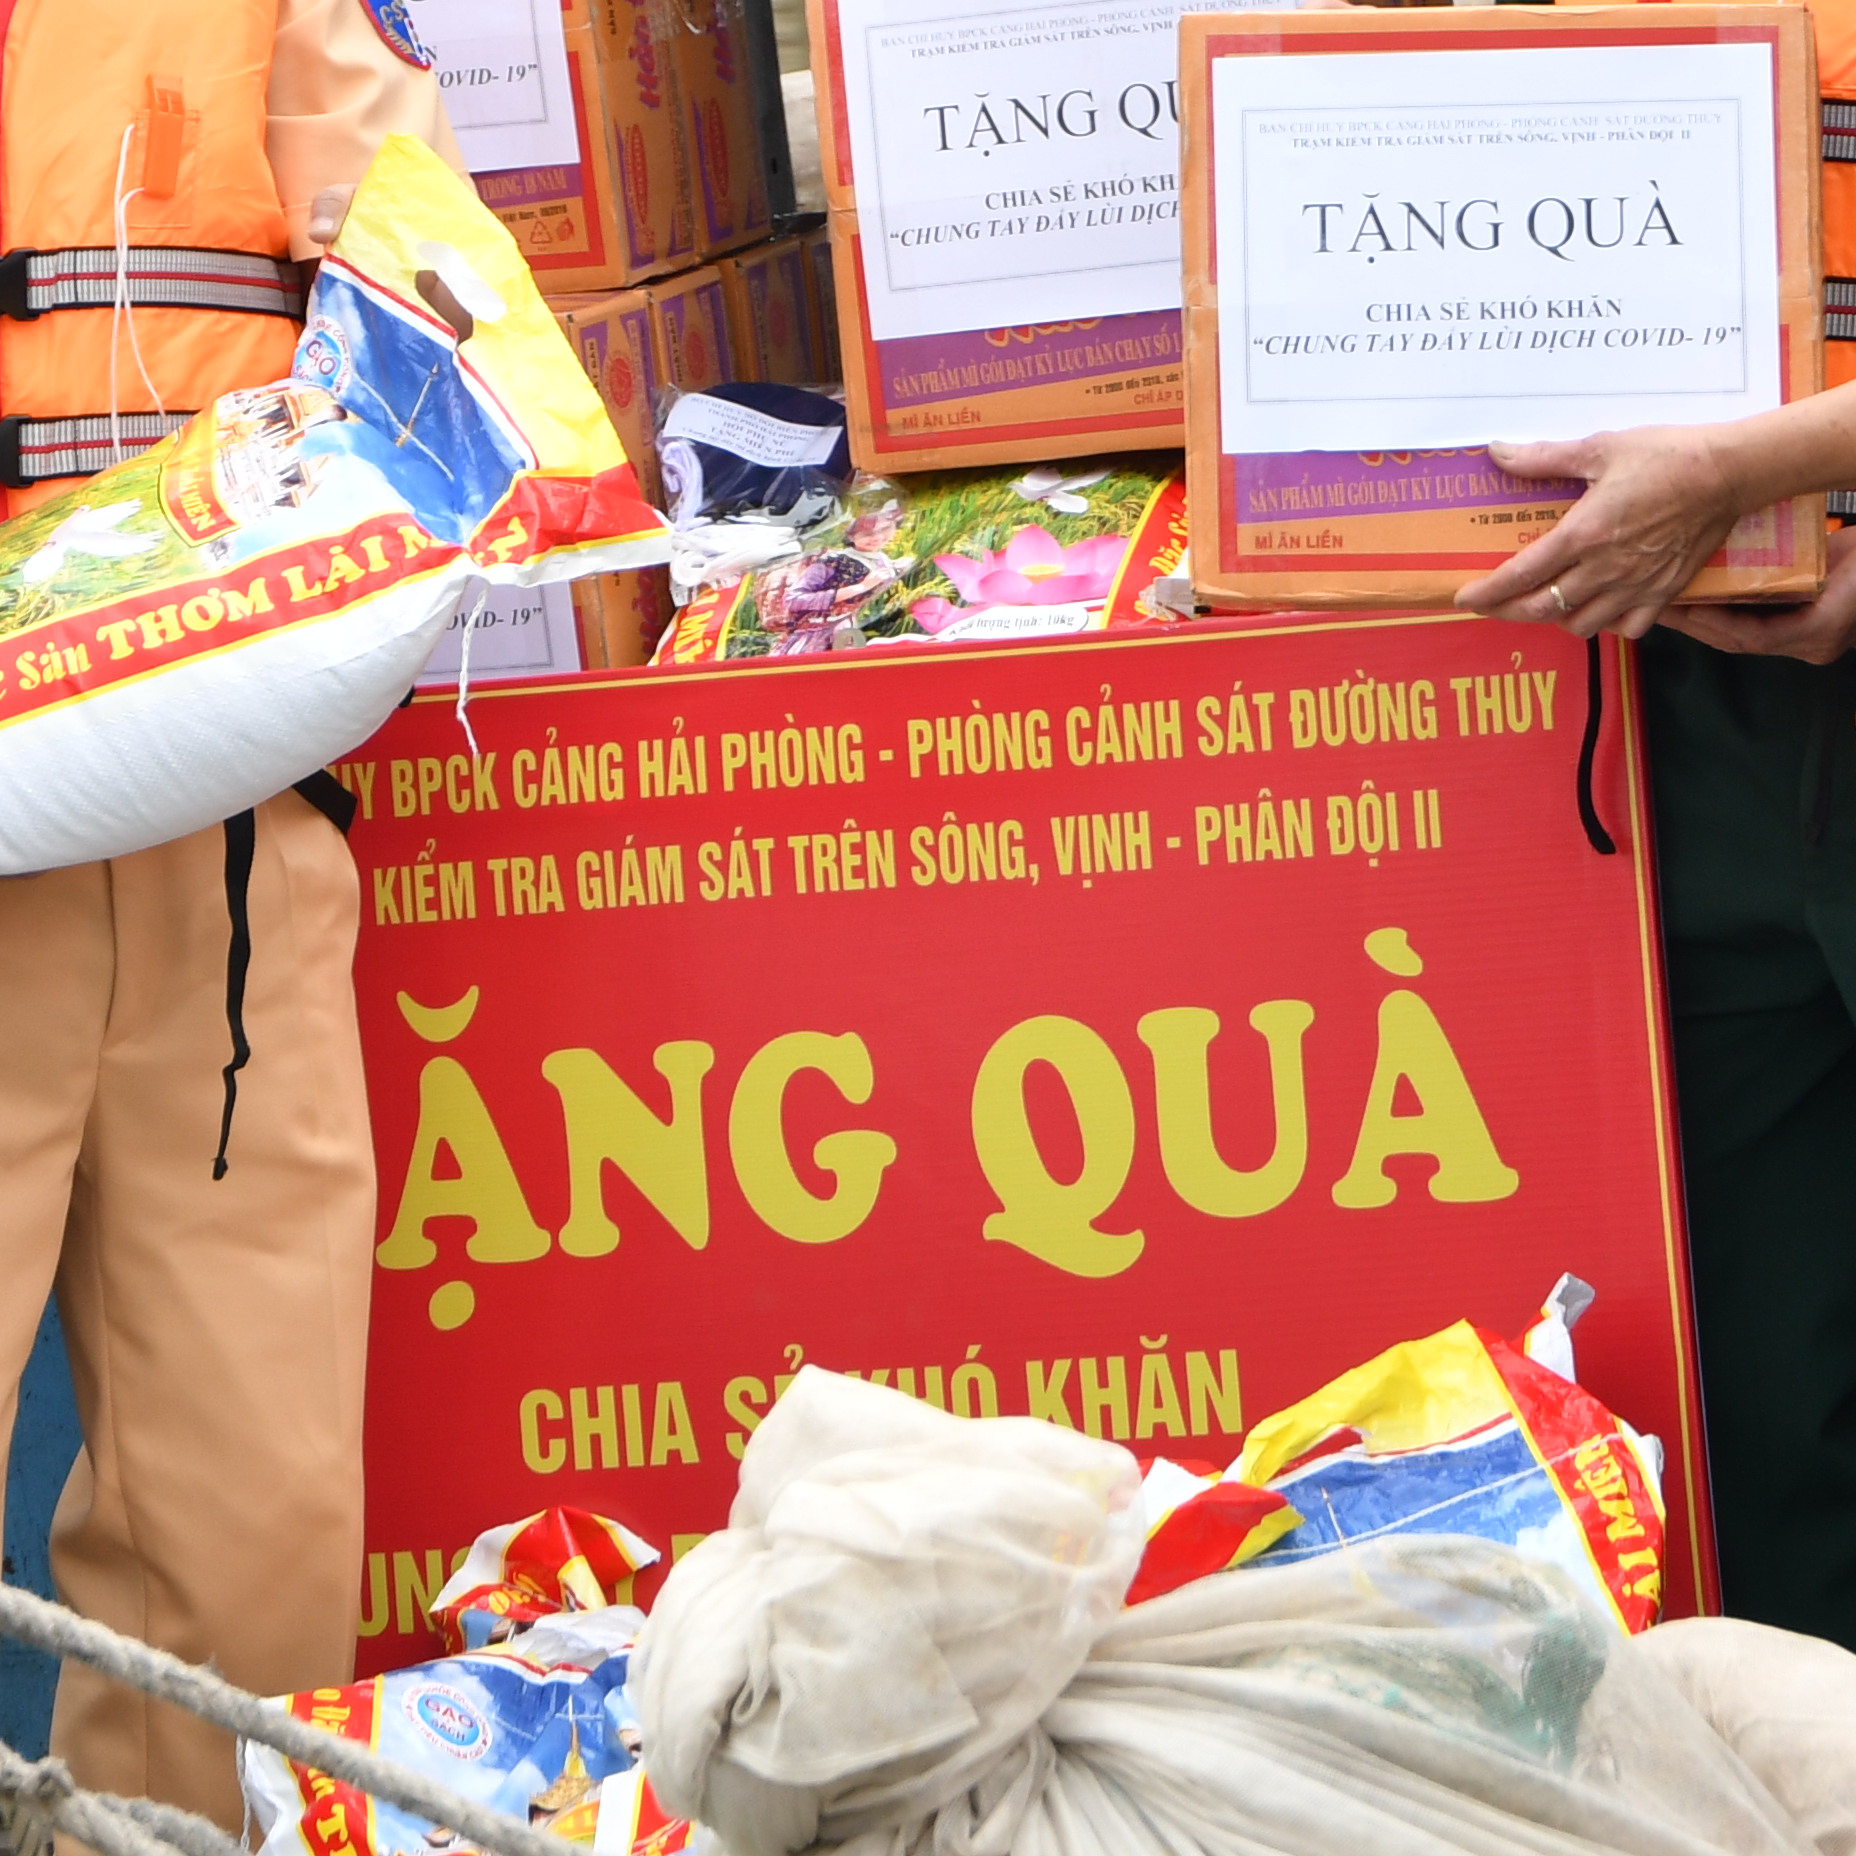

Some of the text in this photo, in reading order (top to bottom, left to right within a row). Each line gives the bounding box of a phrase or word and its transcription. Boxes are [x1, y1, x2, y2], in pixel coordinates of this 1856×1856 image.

[436, 67, 499, 89] OVID-
[923, 90, 1099, 157] TẶNG
[985, 187, 1043, 210] CHIA
[1083, 173, 1135, 201] KHÓ
[987, 215, 1030, 238] TAY
[1085, 200, 1123, 227] LÙI
[1302, 180, 1684, 264] TẶNG QUÀ
[1365, 301, 1433, 323] CHIA
[1479, 294, 1538, 321] KHÓ
[1545, 294, 1623, 319] KHĂN
[1365, 331, 1413, 354] TAY
[1530, 328, 1597, 355] DỊCH
[1602, 326, 1694, 349] COVID-
[1254, 531, 1273, 549] MÌ
[1277, 530, 1301, 548] ĂN
[15, 638, 91, 692] Sản
[96, 570, 275, 662] THƠM
[390, 751, 499, 818] BPCK
[512, 726, 625, 809] CẢNG
[638, 717, 708, 799] HẢI
[721, 713, 865, 792] PHÒNG
[878, 749, 893, 762] -
[907, 699, 1052, 778] PHÒNG
[1065, 683, 1184, 768] CẢNH
[1196, 681, 1277, 757] SÁT
[1289, 669, 1438, 750] ĐƯỜNG
[1449, 651, 1558, 737] THỦY
[373, 779, 1442, 926] KIỂM TRA GIÁM SÁT TRÊN SÔNG, VỊNH - PHÂN ĐỘI II
[375, 927, 1520, 1332] ẶNG QUÀ
[519, 1380, 700, 1475] CHIA
[1026, 1333, 1243, 1441] KHĂN
[1618, 1546, 1662, 1607] ÀI
